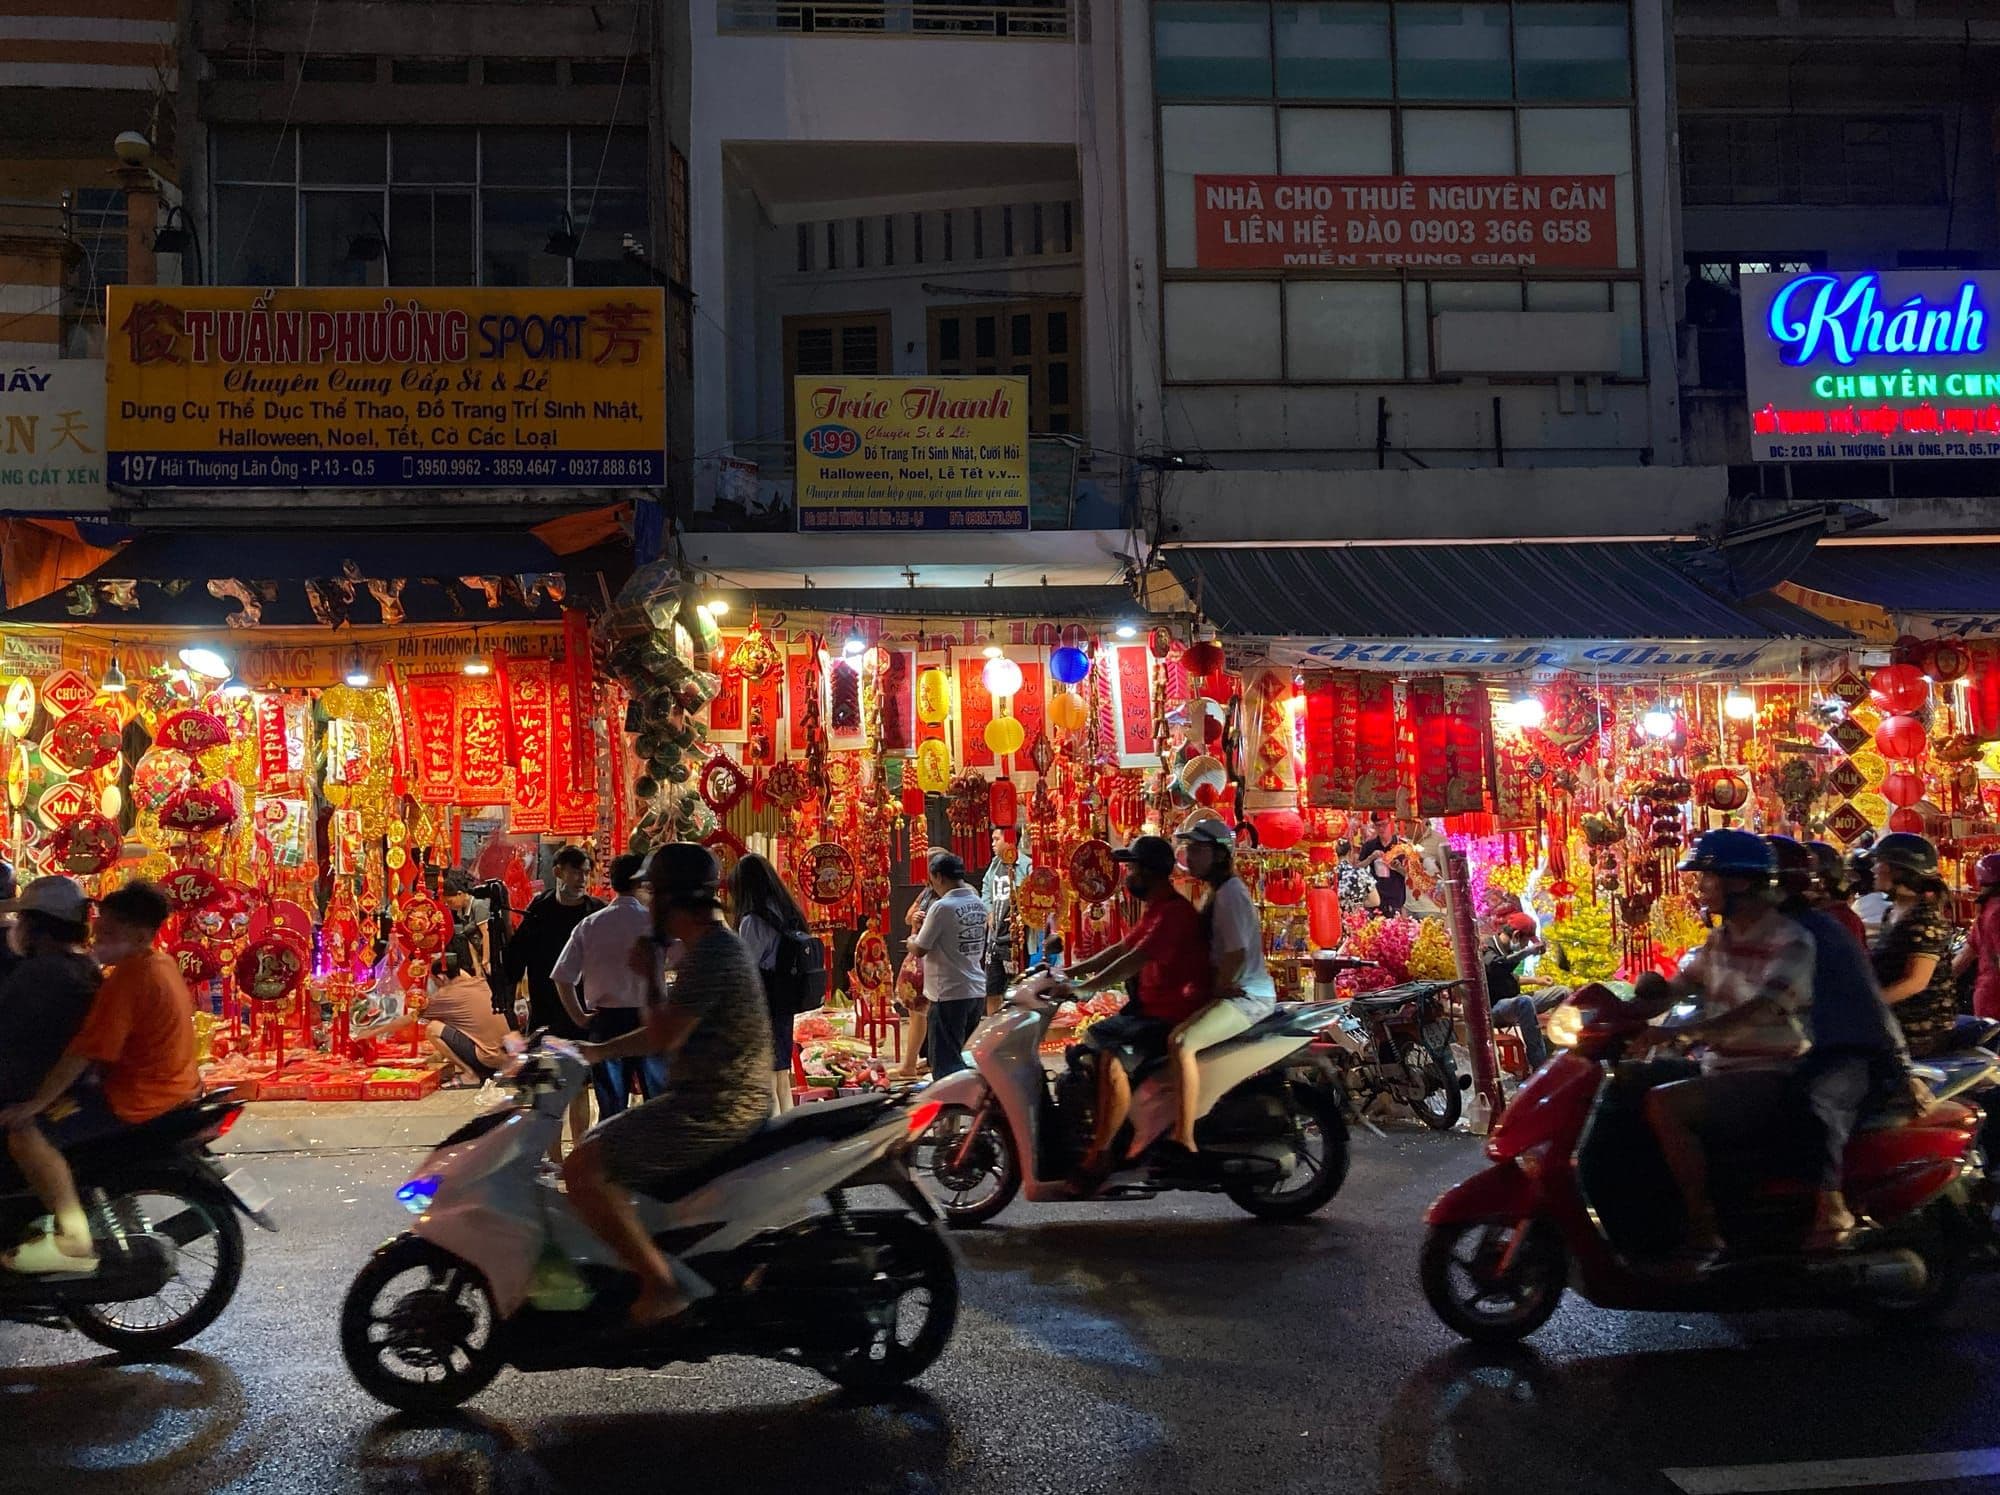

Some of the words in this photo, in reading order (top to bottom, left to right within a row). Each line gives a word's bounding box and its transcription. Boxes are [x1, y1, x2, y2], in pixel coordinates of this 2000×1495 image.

[1206, 181, 1263, 210] NHÀ
[1274, 186, 1333, 210] CHO
[1342, 181, 1415, 210] THUÊ
[1428, 182, 1539, 210] NGUYÊN
[1551, 182, 1607, 210] CĂN
[1223, 216, 1284, 243] LIÊN
[1293, 216, 1338, 248] HỆ:
[1346, 214, 1400, 243] ĐÀO
[1409, 220, 1476, 243] 0903
[1485, 220, 1533, 243] 366
[1542, 220, 1591, 243] 658
[1366, 253, 1461, 265] TRUNG
[1471, 253, 1536, 265] GIAN
[184, 288, 301, 364] TUẤN
[479, 315, 587, 360] SPORT
[1770, 273, 1985, 364] Khánh
[223, 367, 320, 396] Chuyên
[328, 367, 392, 396] Cung
[400, 367, 449, 395] Cấp
[491, 371, 506, 391] &
[1815, 368, 1938, 397] CHUYÊN
[121, 401, 176, 422] Dụng
[182, 401, 210, 422] Cụ
[217, 397, 254, 418] Thể
[264, 401, 303, 422] Dục
[310, 397, 345, 418] Thể
[355, 401, 409, 422] Thao,
[452, 402, 506, 422] Trang
[513, 397, 537, 418] Trí
[544, 402, 585, 418] Sinh
[594, 402, 643, 422] Nhật,
[811, 386, 892, 420] Trúc
[901, 383, 1012, 420] Thanh
[48, 411, 96, 453] 天
[219, 428, 323, 448] Halloween,
[328, 428, 380, 448] Noel,
[387, 424, 424, 448] Tết,
[468, 426, 505, 445] Các
[515, 428, 557, 449] Loại
[810, 431, 857, 454] 199
[936, 426, 945, 438] &
[881, 446, 909, 462] Trang
[929, 446, 949, 460] Sinh
[1791, 445, 1813, 457] 203
[121, 456, 157, 481] 197
[187, 458, 239, 481] Thượng
[271, 457, 299, 480] Ông
[311, 459, 340, 477] P.13
[352, 459, 375, 479] Q.5
[417, 459, 480, 476] 3950.9962
[493, 459, 557, 476] 3859.4647
[569, 459, 652, 477] 0937.888.613
[820, 468, 894, 481] Halloween,
[899, 468, 933, 481] Noel,
